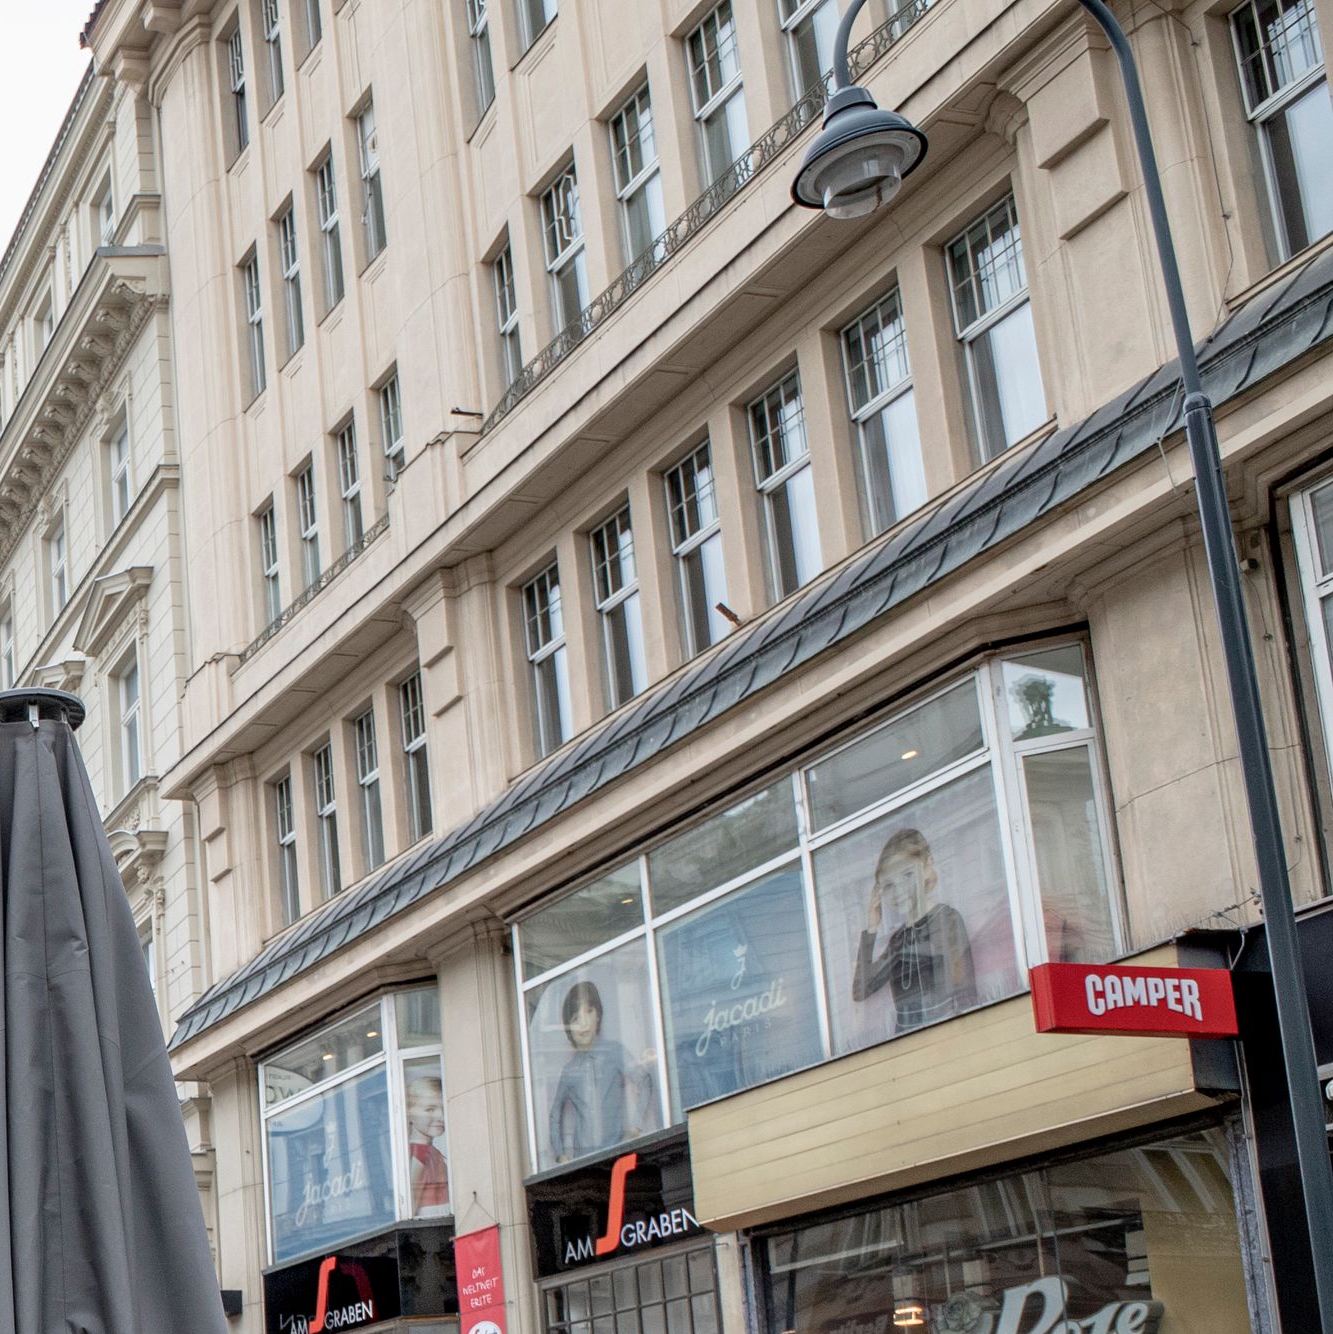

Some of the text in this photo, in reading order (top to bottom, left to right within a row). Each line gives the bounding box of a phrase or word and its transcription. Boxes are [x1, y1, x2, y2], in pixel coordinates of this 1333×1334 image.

[695, 977, 787, 1057] jacadi
[1085, 973, 1203, 1022] CAMPER
[719, 1017, 772, 1048] PARIS
[295, 1160, 364, 1227] jacadi
[564, 1207, 700, 1264] AM GRABEN
[324, 1299, 374, 1330] GRABEN
